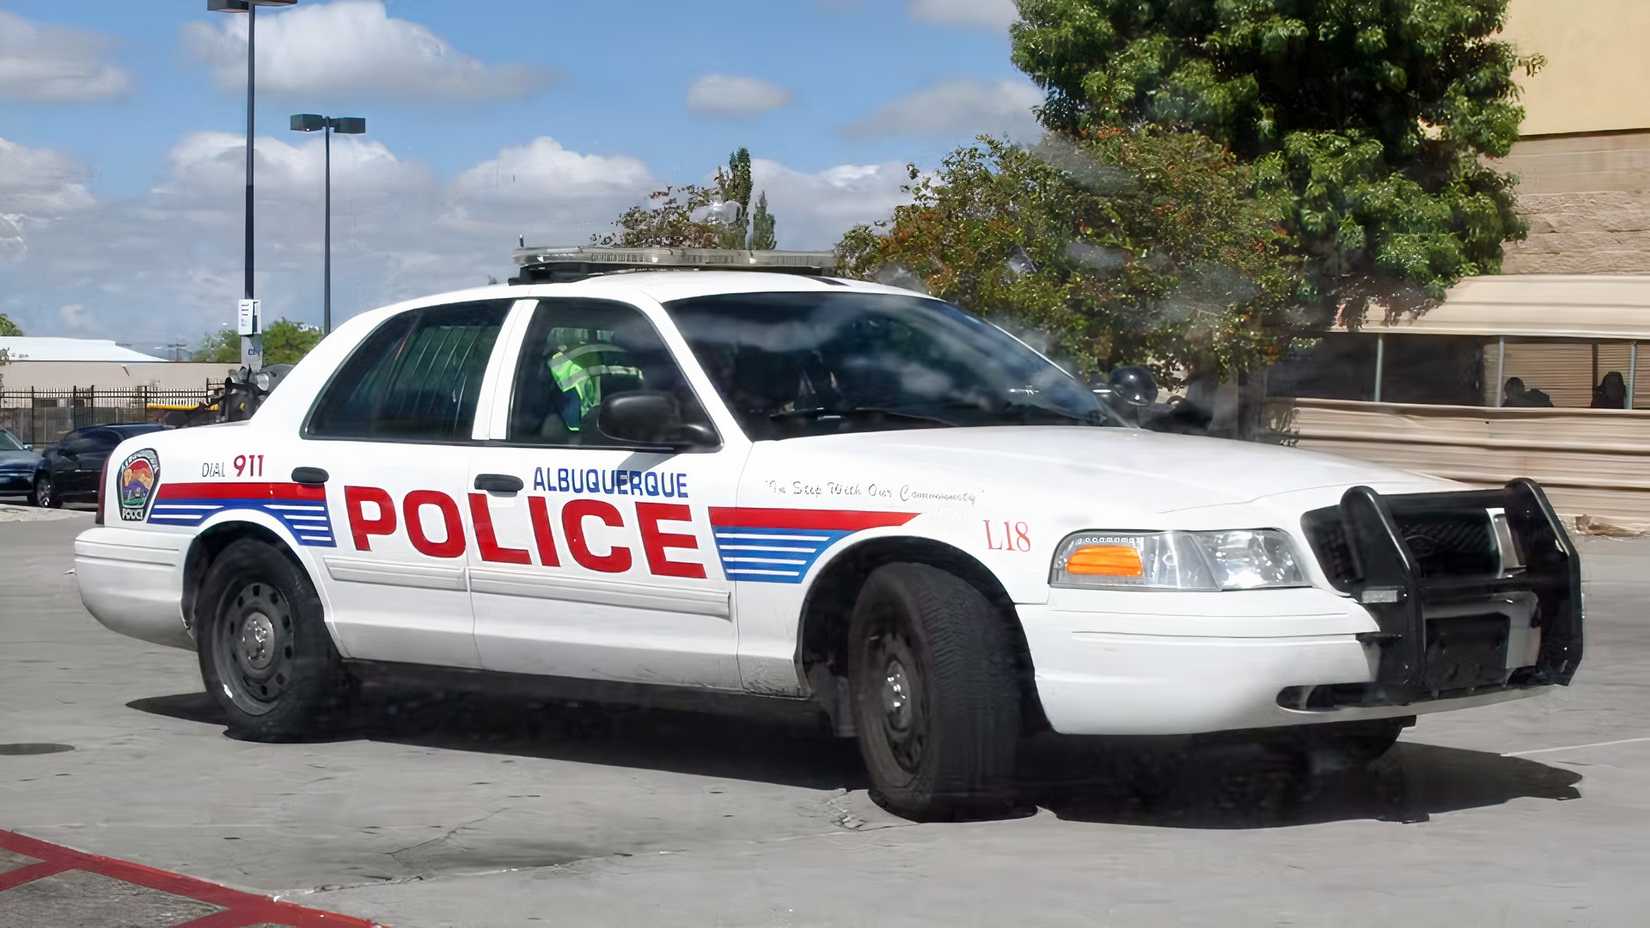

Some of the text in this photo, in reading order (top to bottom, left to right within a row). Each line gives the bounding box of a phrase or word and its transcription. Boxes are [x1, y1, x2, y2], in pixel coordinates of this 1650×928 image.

[202, 454, 264, 477] DIAL 911
[533, 466, 688, 498] ALBUQUERQUE
[344, 485, 707, 579] POLICE
[982, 519, 1031, 552] L18
